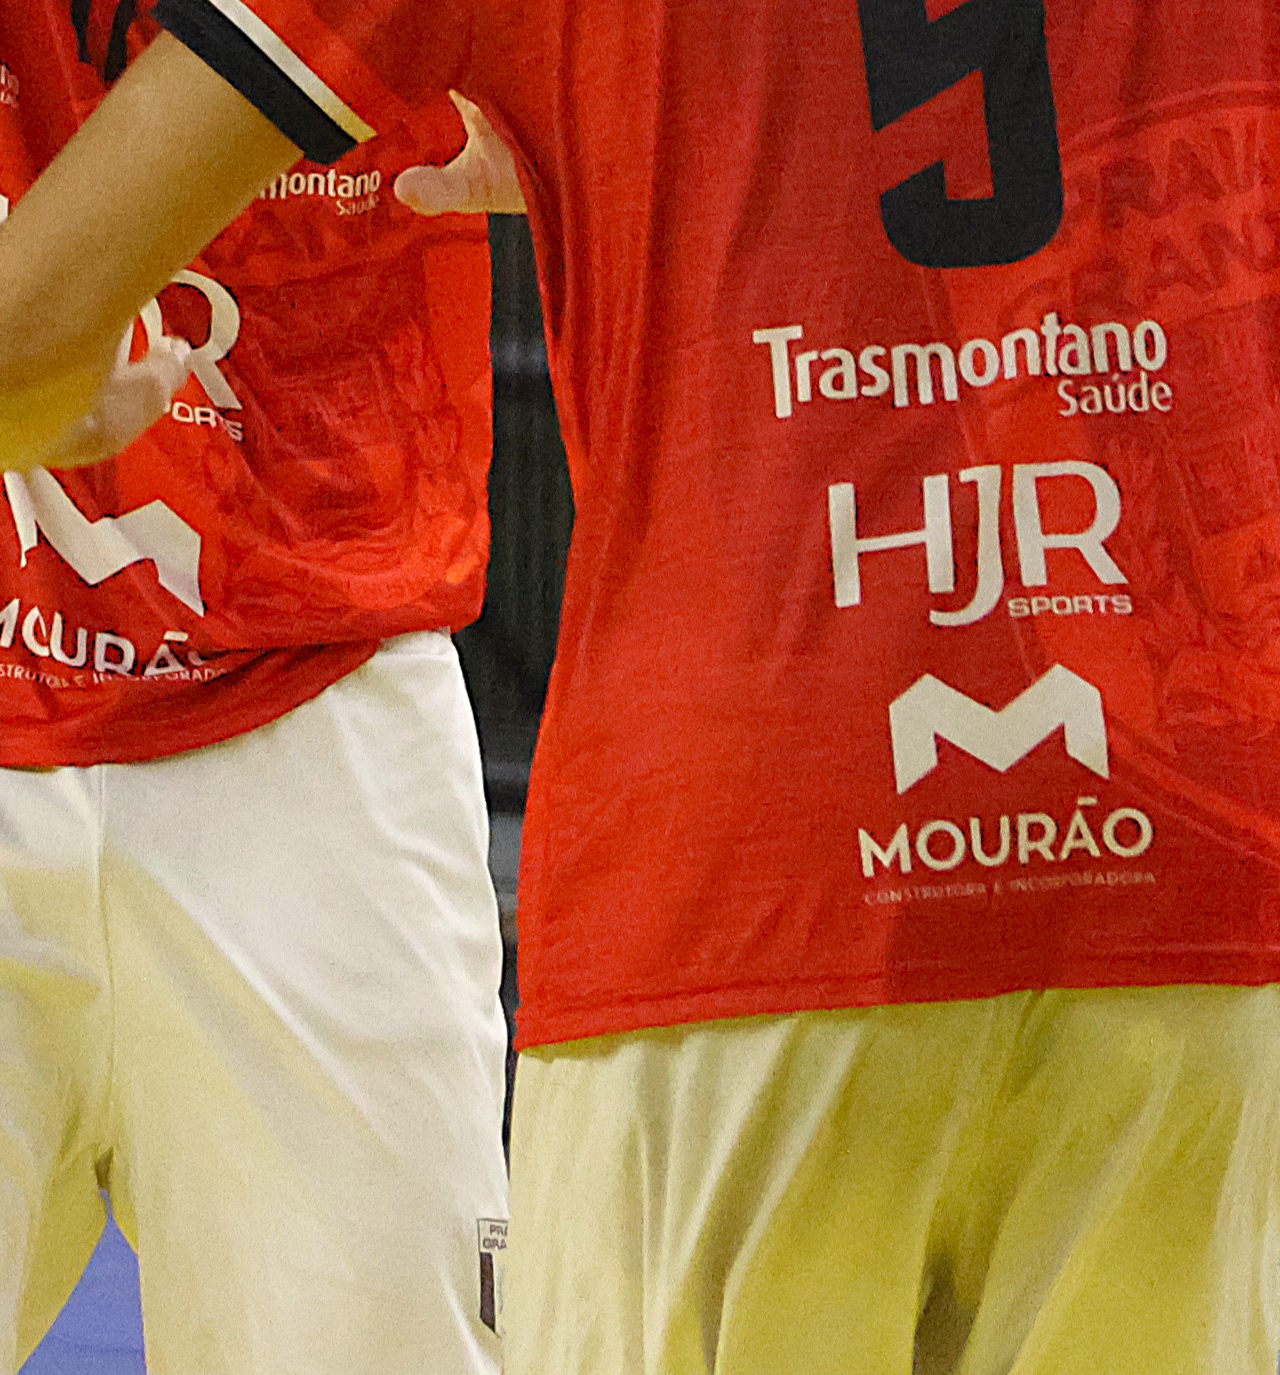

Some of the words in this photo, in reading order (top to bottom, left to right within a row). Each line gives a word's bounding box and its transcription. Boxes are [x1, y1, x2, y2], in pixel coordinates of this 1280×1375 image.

[752, 311, 1169, 420] Trasmontano
[1058, 372, 1174, 417] Saúde
[828, 460, 1130, 626] HJR
[1007, 594, 1134, 619] SPORTS
[857, 796, 1155, 879] MOURÃO
